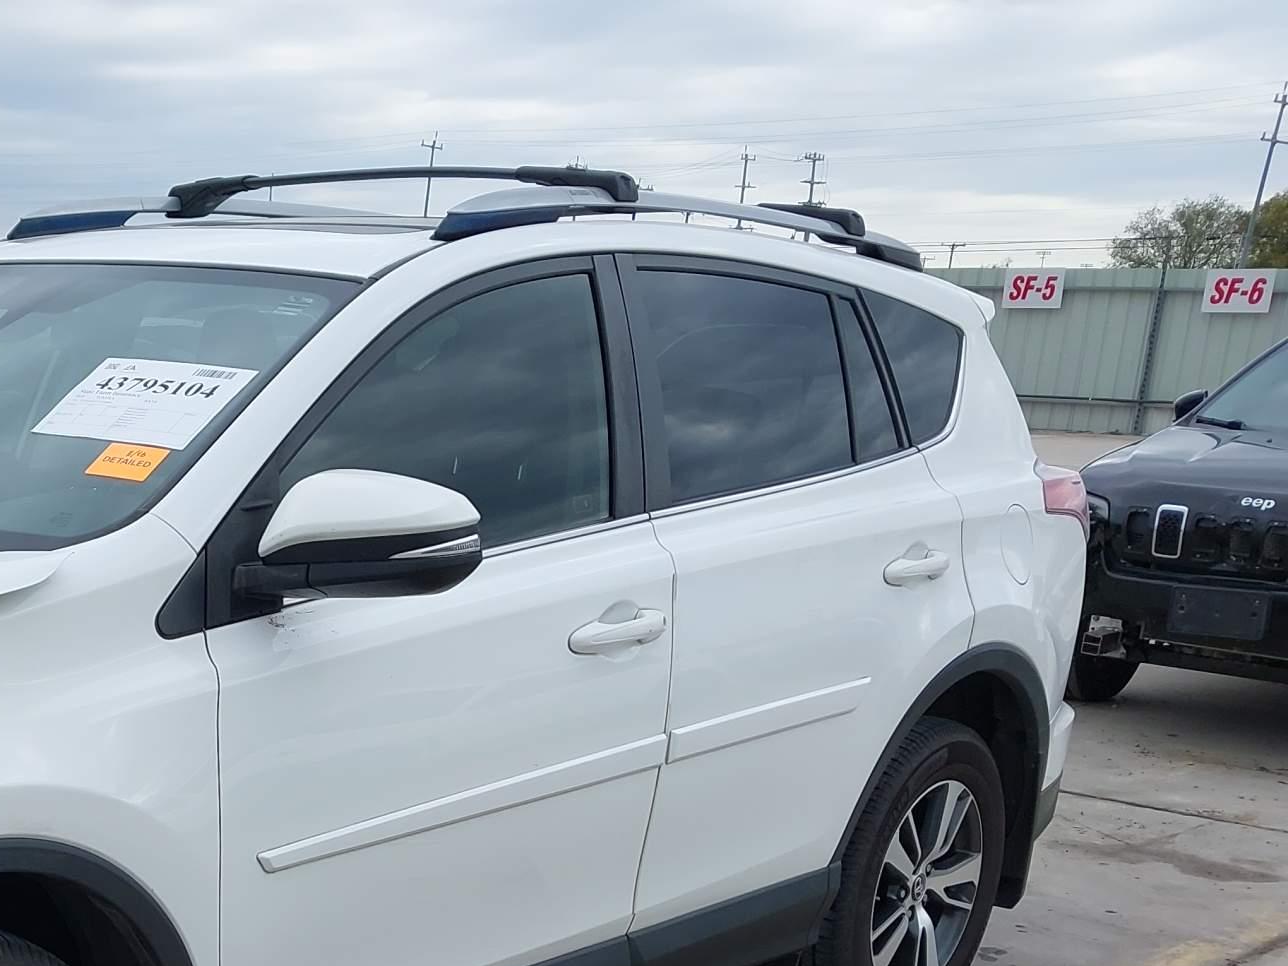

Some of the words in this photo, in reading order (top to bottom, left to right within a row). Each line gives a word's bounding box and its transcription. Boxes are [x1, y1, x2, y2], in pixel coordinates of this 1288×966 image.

[1008, 274, 1059, 302] SF-5
[1209, 276, 1268, 306] SF-6
[95, 375, 221, 399] 43795104
[102, 455, 152, 468] DETAILED
[1240, 496, 1276, 511] eep
